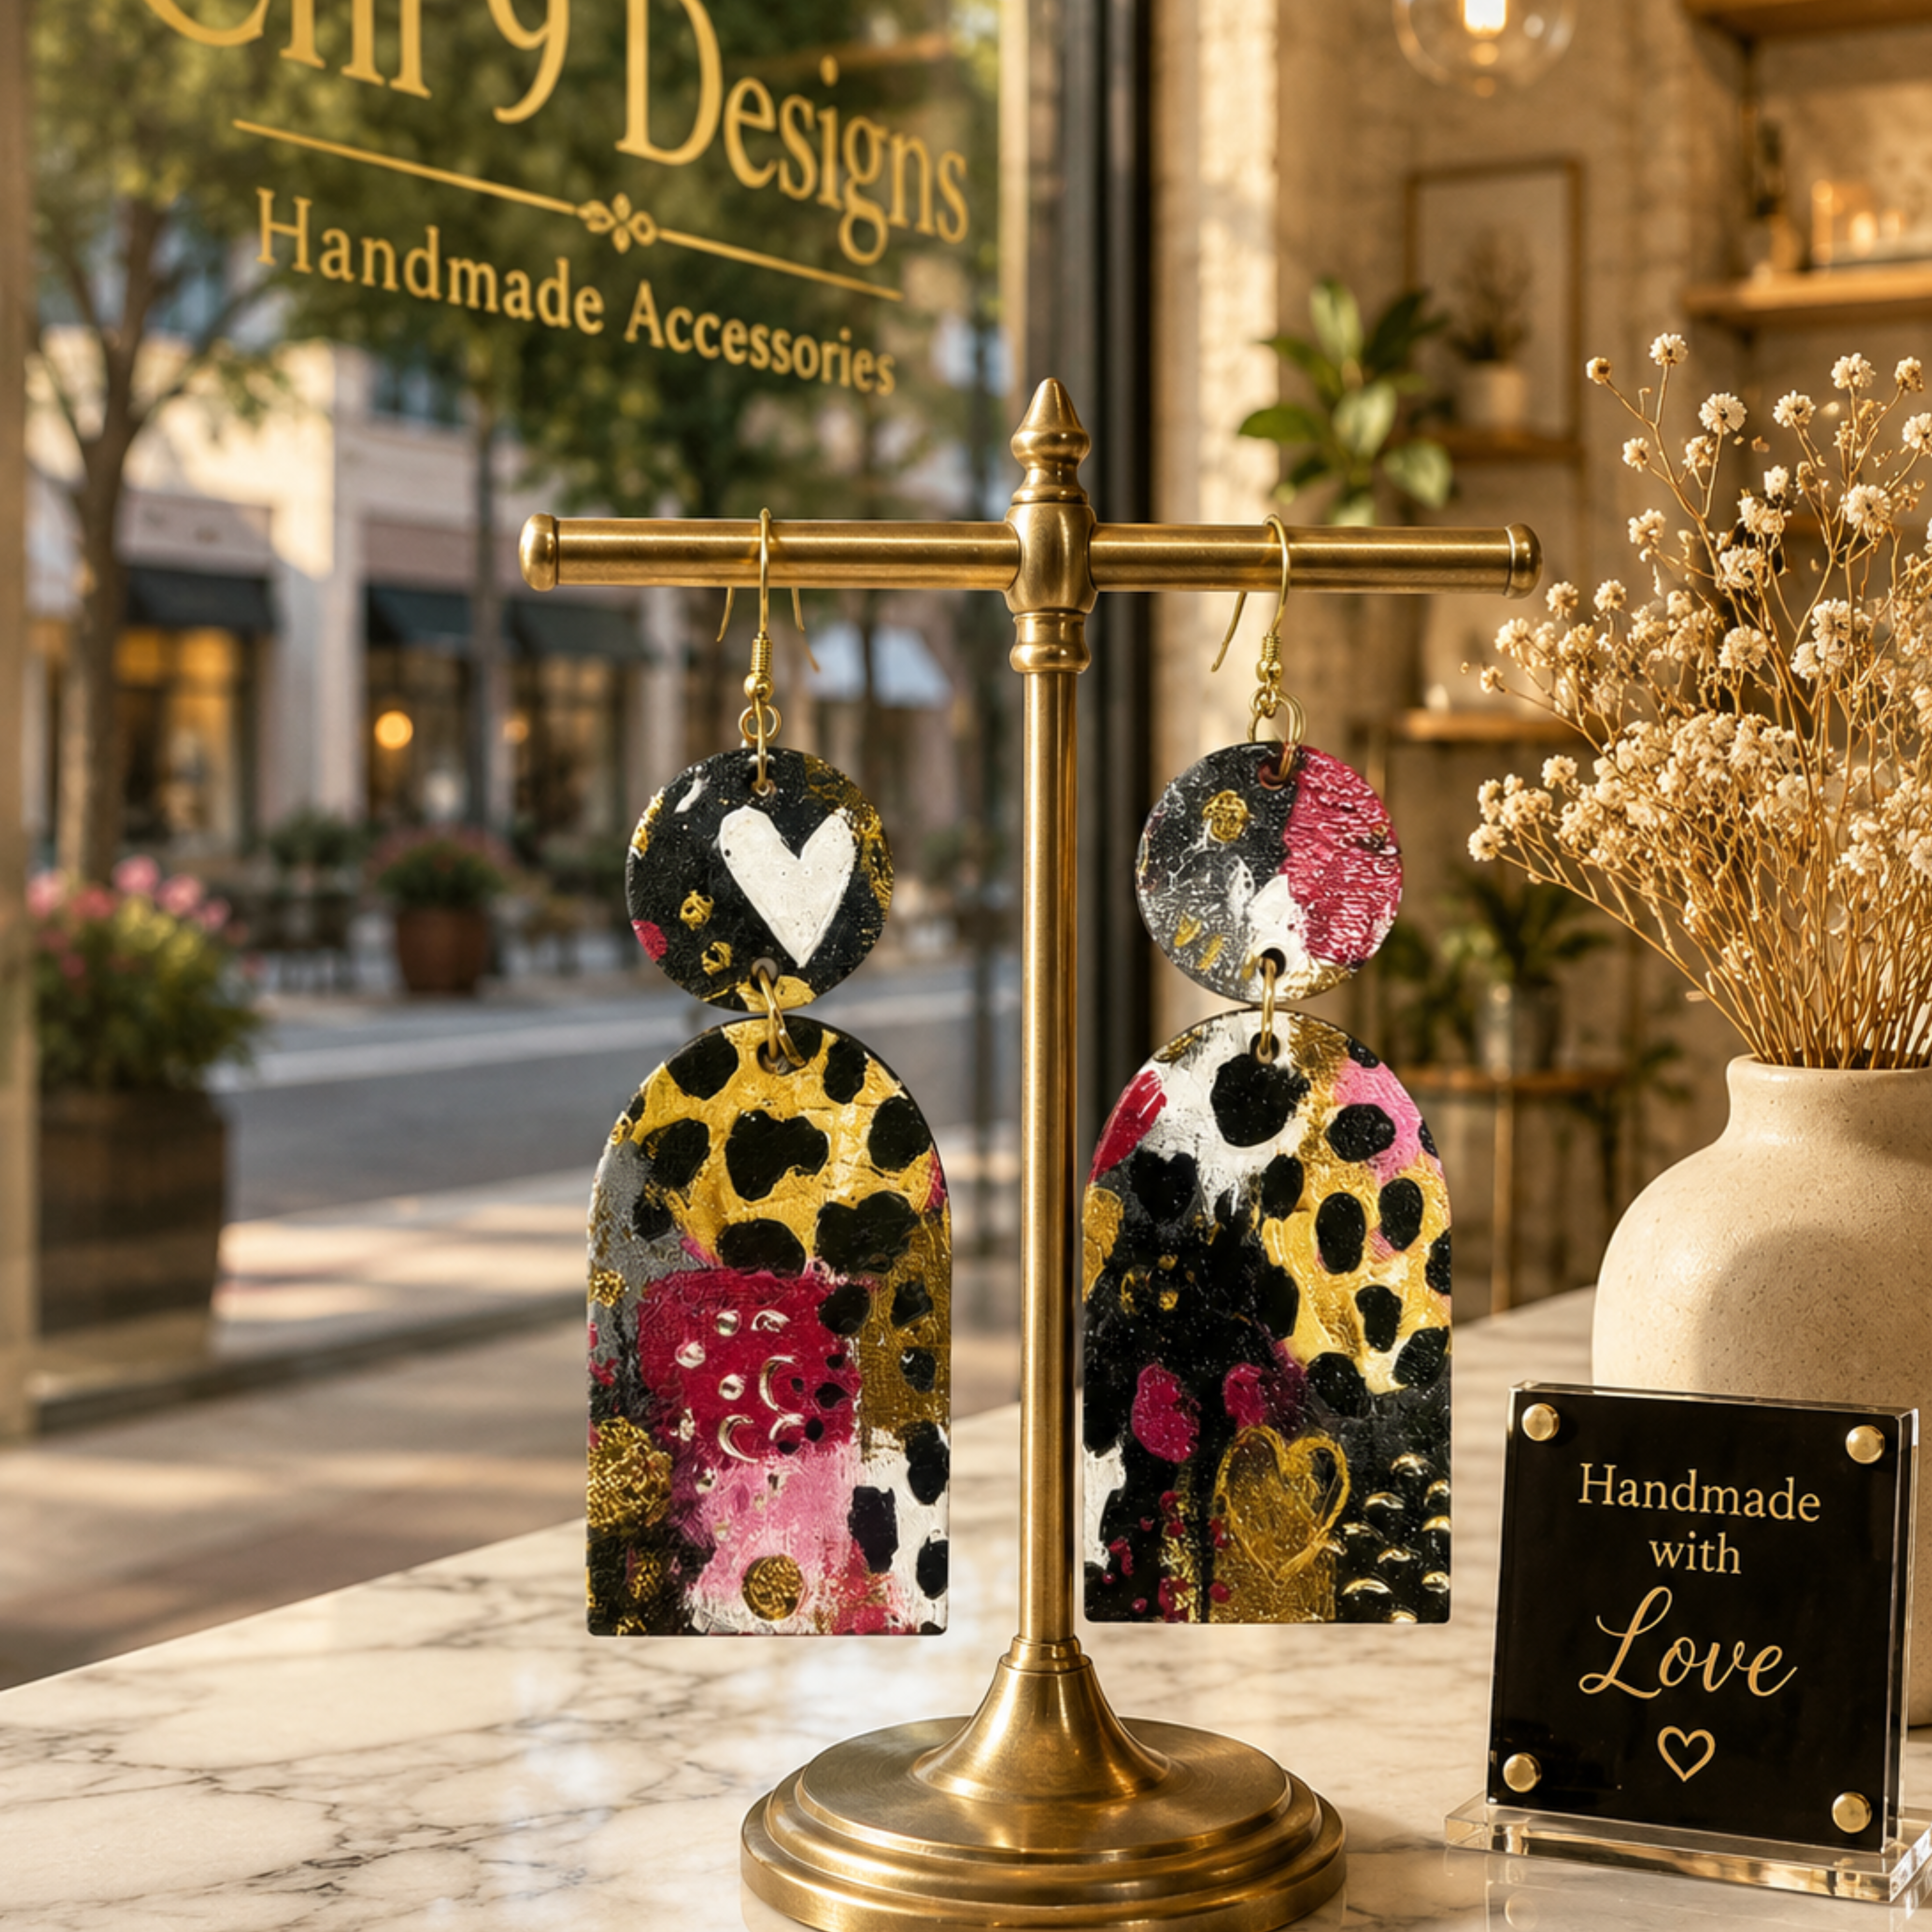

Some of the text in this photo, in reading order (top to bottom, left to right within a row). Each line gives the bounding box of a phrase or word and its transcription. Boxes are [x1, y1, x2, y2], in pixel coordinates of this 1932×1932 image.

[615, 0, 968, 265] Designs
[256, 187, 896, 397] Handmade Accessories
[1578, 1463, 1821, 1522] Handmade
[1648, 1531, 1742, 1575] with
[1578, 1586, 1798, 1699] Love
